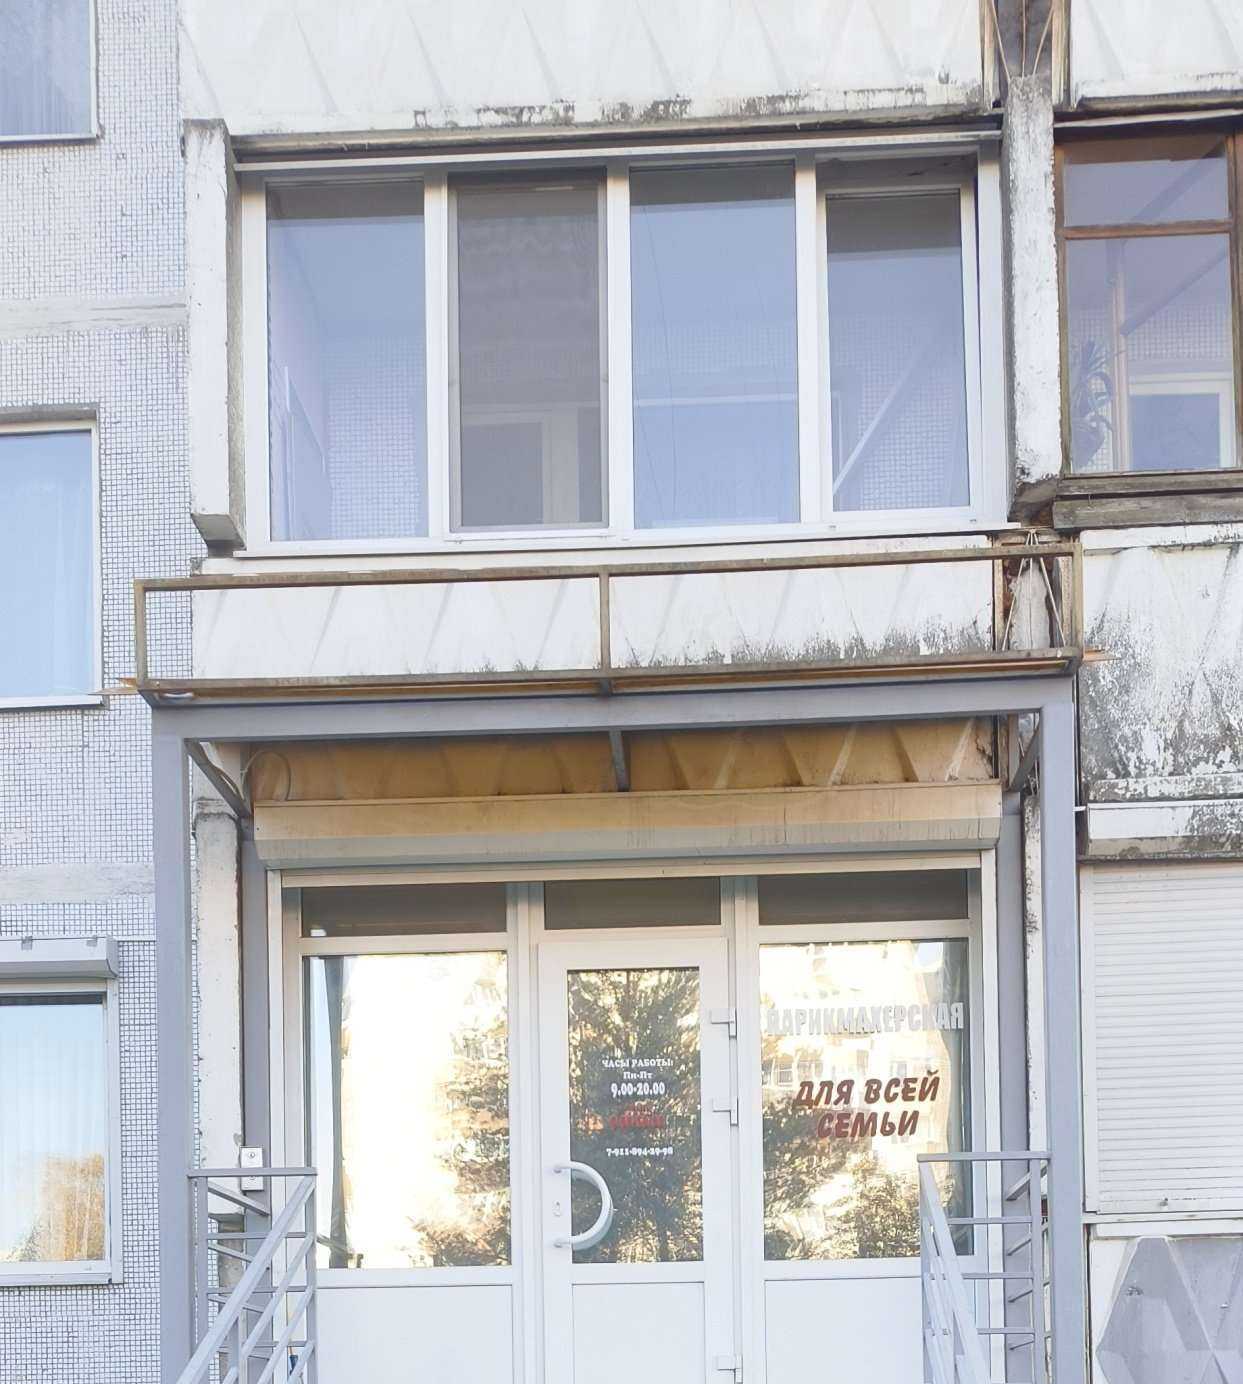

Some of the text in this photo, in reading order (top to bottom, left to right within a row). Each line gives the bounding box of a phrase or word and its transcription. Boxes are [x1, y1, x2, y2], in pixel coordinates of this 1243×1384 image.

[767, 1002, 964, 1036] ПАРИКМАХЕРСКАЯ
[602, 1059, 673, 1068] ЧАСЫ РАБОТЫ:
[623, 1071, 654, 1080] Пн-Пт
[610, 1081, 666, 1098] 9.00-20.00
[792, 1069, 940, 1109] ДЛЯ ВСЕЙ
[817, 1110, 920, 1138] СЕМЬИ
